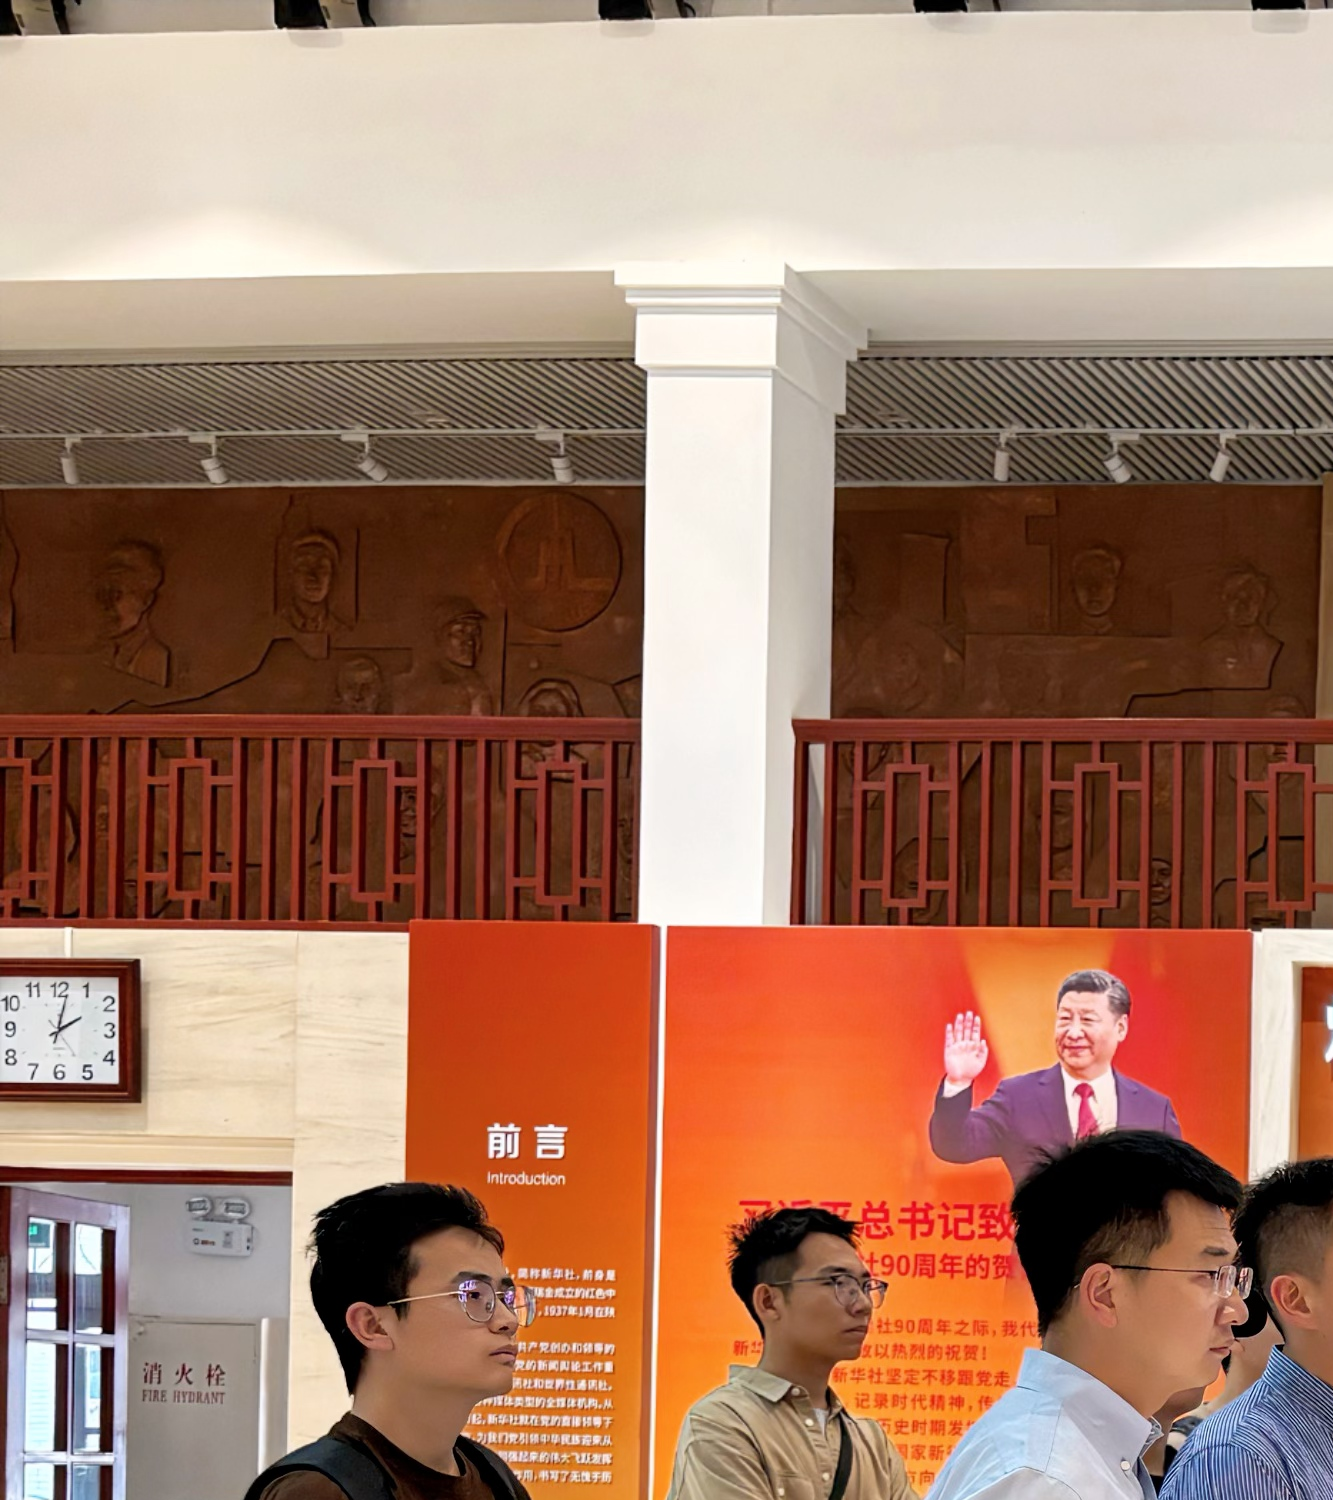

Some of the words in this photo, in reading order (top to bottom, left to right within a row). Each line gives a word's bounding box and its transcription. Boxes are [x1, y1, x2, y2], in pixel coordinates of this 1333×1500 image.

[25, 981, 41, 998] 11
[50, 981, 70, 998] 12
[82, 982, 90, 998] 1
[1, 995, 20, 1012] 10
[102, 995, 116, 1012] 2
[4, 1021, 17, 1037] 9
[104, 1022, 116, 1039] 3
[4, 1048, 17, 1066] 8
[102, 1050, 116, 1066] 4
[27, 1063, 39, 1080] 7
[53, 1064, 66, 1080] 6
[81, 1064, 93, 1080] 5
[487, 1123, 568, 1159] 前言
[487, 1171, 566, 1186] Introduction
[740, 1200, 1015, 1242] 总书记致
[505, 1267, 616, 1282] ，简称新华社，前身是
[870, 1319, 1037, 1338] 社90周年之际，我代
[143, 1362, 226, 1387] 消火栓
[832, 1368, 1011, 1387] 新华社坚定不移跟党走
[142, 1389, 167, 1403] FIRE
[173, 1390, 225, 1404] HYDRANT
[477, 1395, 613, 1409] 种媒体类型的全媒体机构。从
[461, 1432, 613, 1447] ，为我们党引领中华民族迎来从
